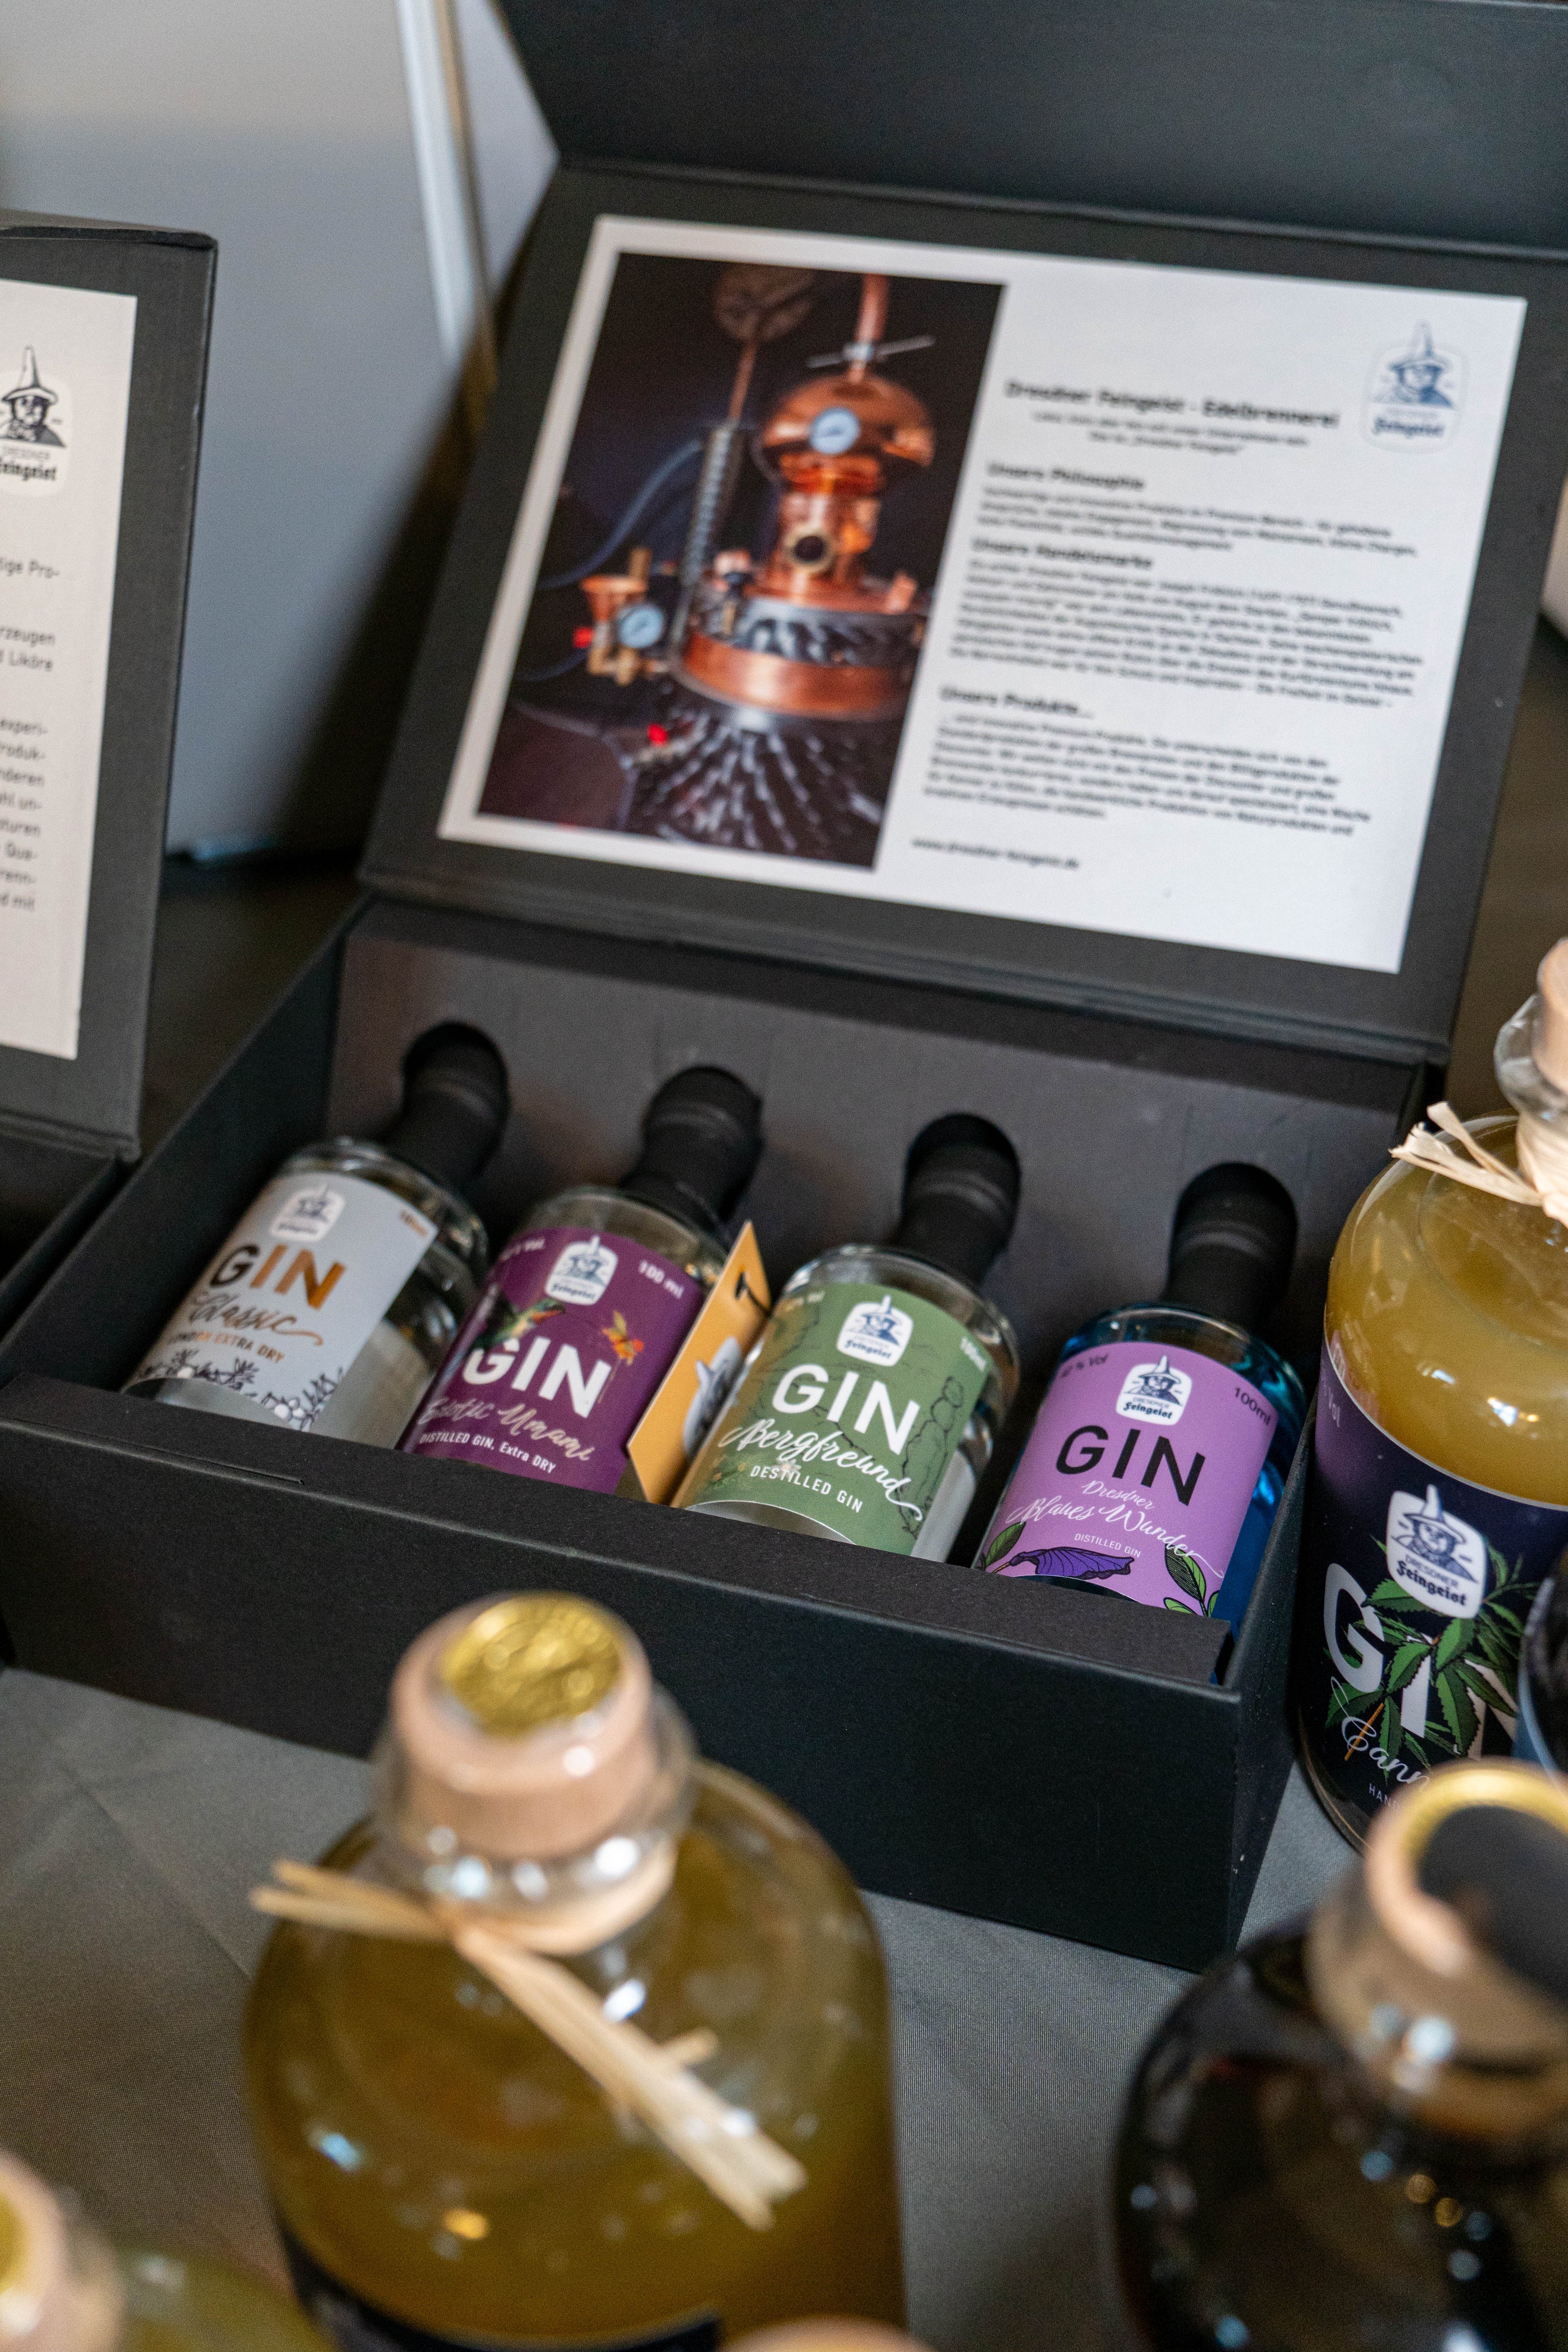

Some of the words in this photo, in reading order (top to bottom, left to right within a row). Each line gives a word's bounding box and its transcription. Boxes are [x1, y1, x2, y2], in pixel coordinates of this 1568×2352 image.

[209, 1243, 347, 1311] GIN
[638, 1260, 665, 1284] 100
[257, 1344, 285, 1364] DRY
[844, 1339, 892, 1359] Feingeist
[462, 1336, 612, 1419] GIN
[772, 1363, 921, 1455] GIN
[1123, 1401, 1173, 1420] Feingeist
[1132, 1396, 1170, 1409] DRESDNER
[1235, 1387, 1272, 1425] 100ml
[419, 1430, 469, 1445] DISTILLED
[499, 1441, 530, 1462] Extra
[532, 1454, 557, 1474] DRY
[497, 1403, 595, 1461] Umami
[718, 1418, 924, 1521] Bergfreund
[1055, 1425, 1206, 1507] GIN
[750, 1466, 832, 1495] DESTILLED
[836, 1490, 863, 1513] GIN
[1081, 1480, 1155, 1511] Dresdner
[1005, 1495, 1095, 1525] Blaues
[1099, 1504, 1225, 1579] Wunder
[1074, 1533, 1122, 1551] DISTILLED
[1124, 1545, 1141, 1559] GIN
[1396, 1560, 1466, 1606] Feingeist
[1405, 1554, 1459, 1589] DRESDNER
[1331, 1676, 1431, 1785] Cann
[1369, 1783, 1396, 1810] HAN
